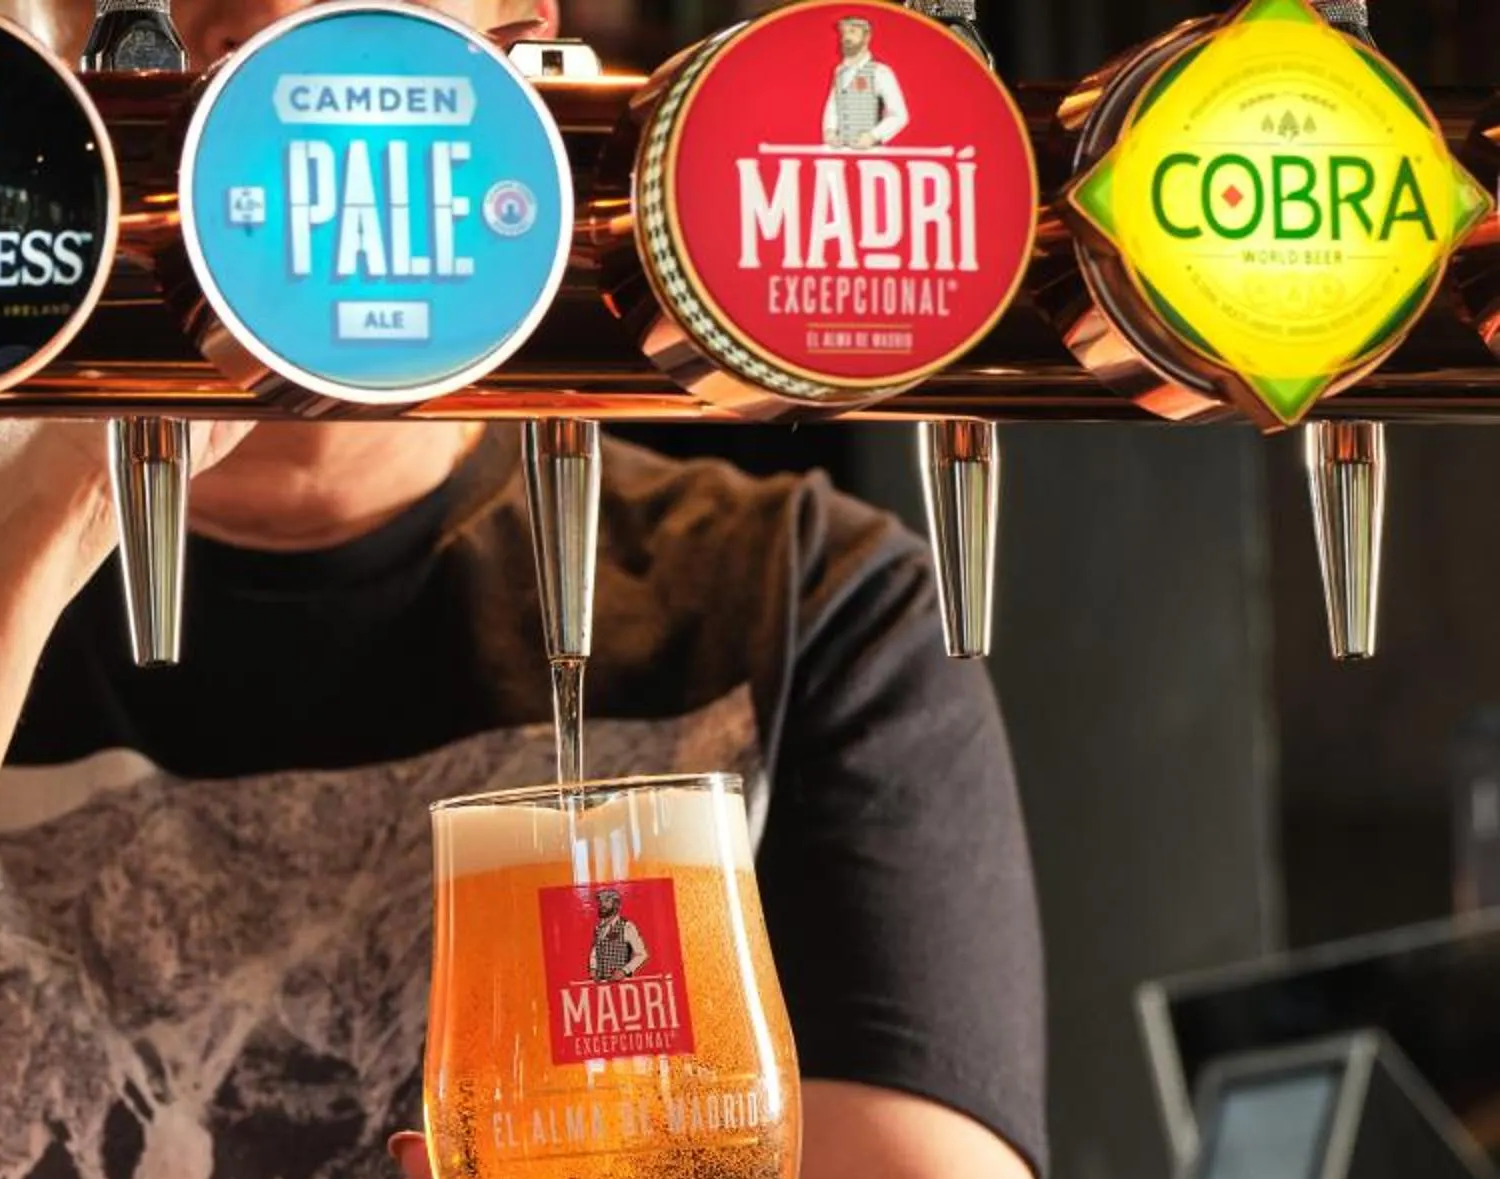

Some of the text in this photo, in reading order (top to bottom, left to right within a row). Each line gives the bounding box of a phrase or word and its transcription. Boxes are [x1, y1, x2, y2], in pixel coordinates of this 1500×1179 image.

[289, 86, 457, 113] CAMDEN
[286, 139, 474, 277] PALE
[736, 145, 980, 271] MADRÍ
[1150, 152, 1438, 242] COBRA
[1242, 249, 1343, 266] WORLD BEER
[3, 304, 71, 317] IRELAND
[768, 275, 951, 316] EXCEPCIONAL
[363, 312, 405, 329] ALE
[560, 973, 680, 1036] MADRÍ
[493, 1111, 517, 1148] EL
[532, 1102, 604, 1147] ALMA
[667, 1091, 758, 1135] MADRID
